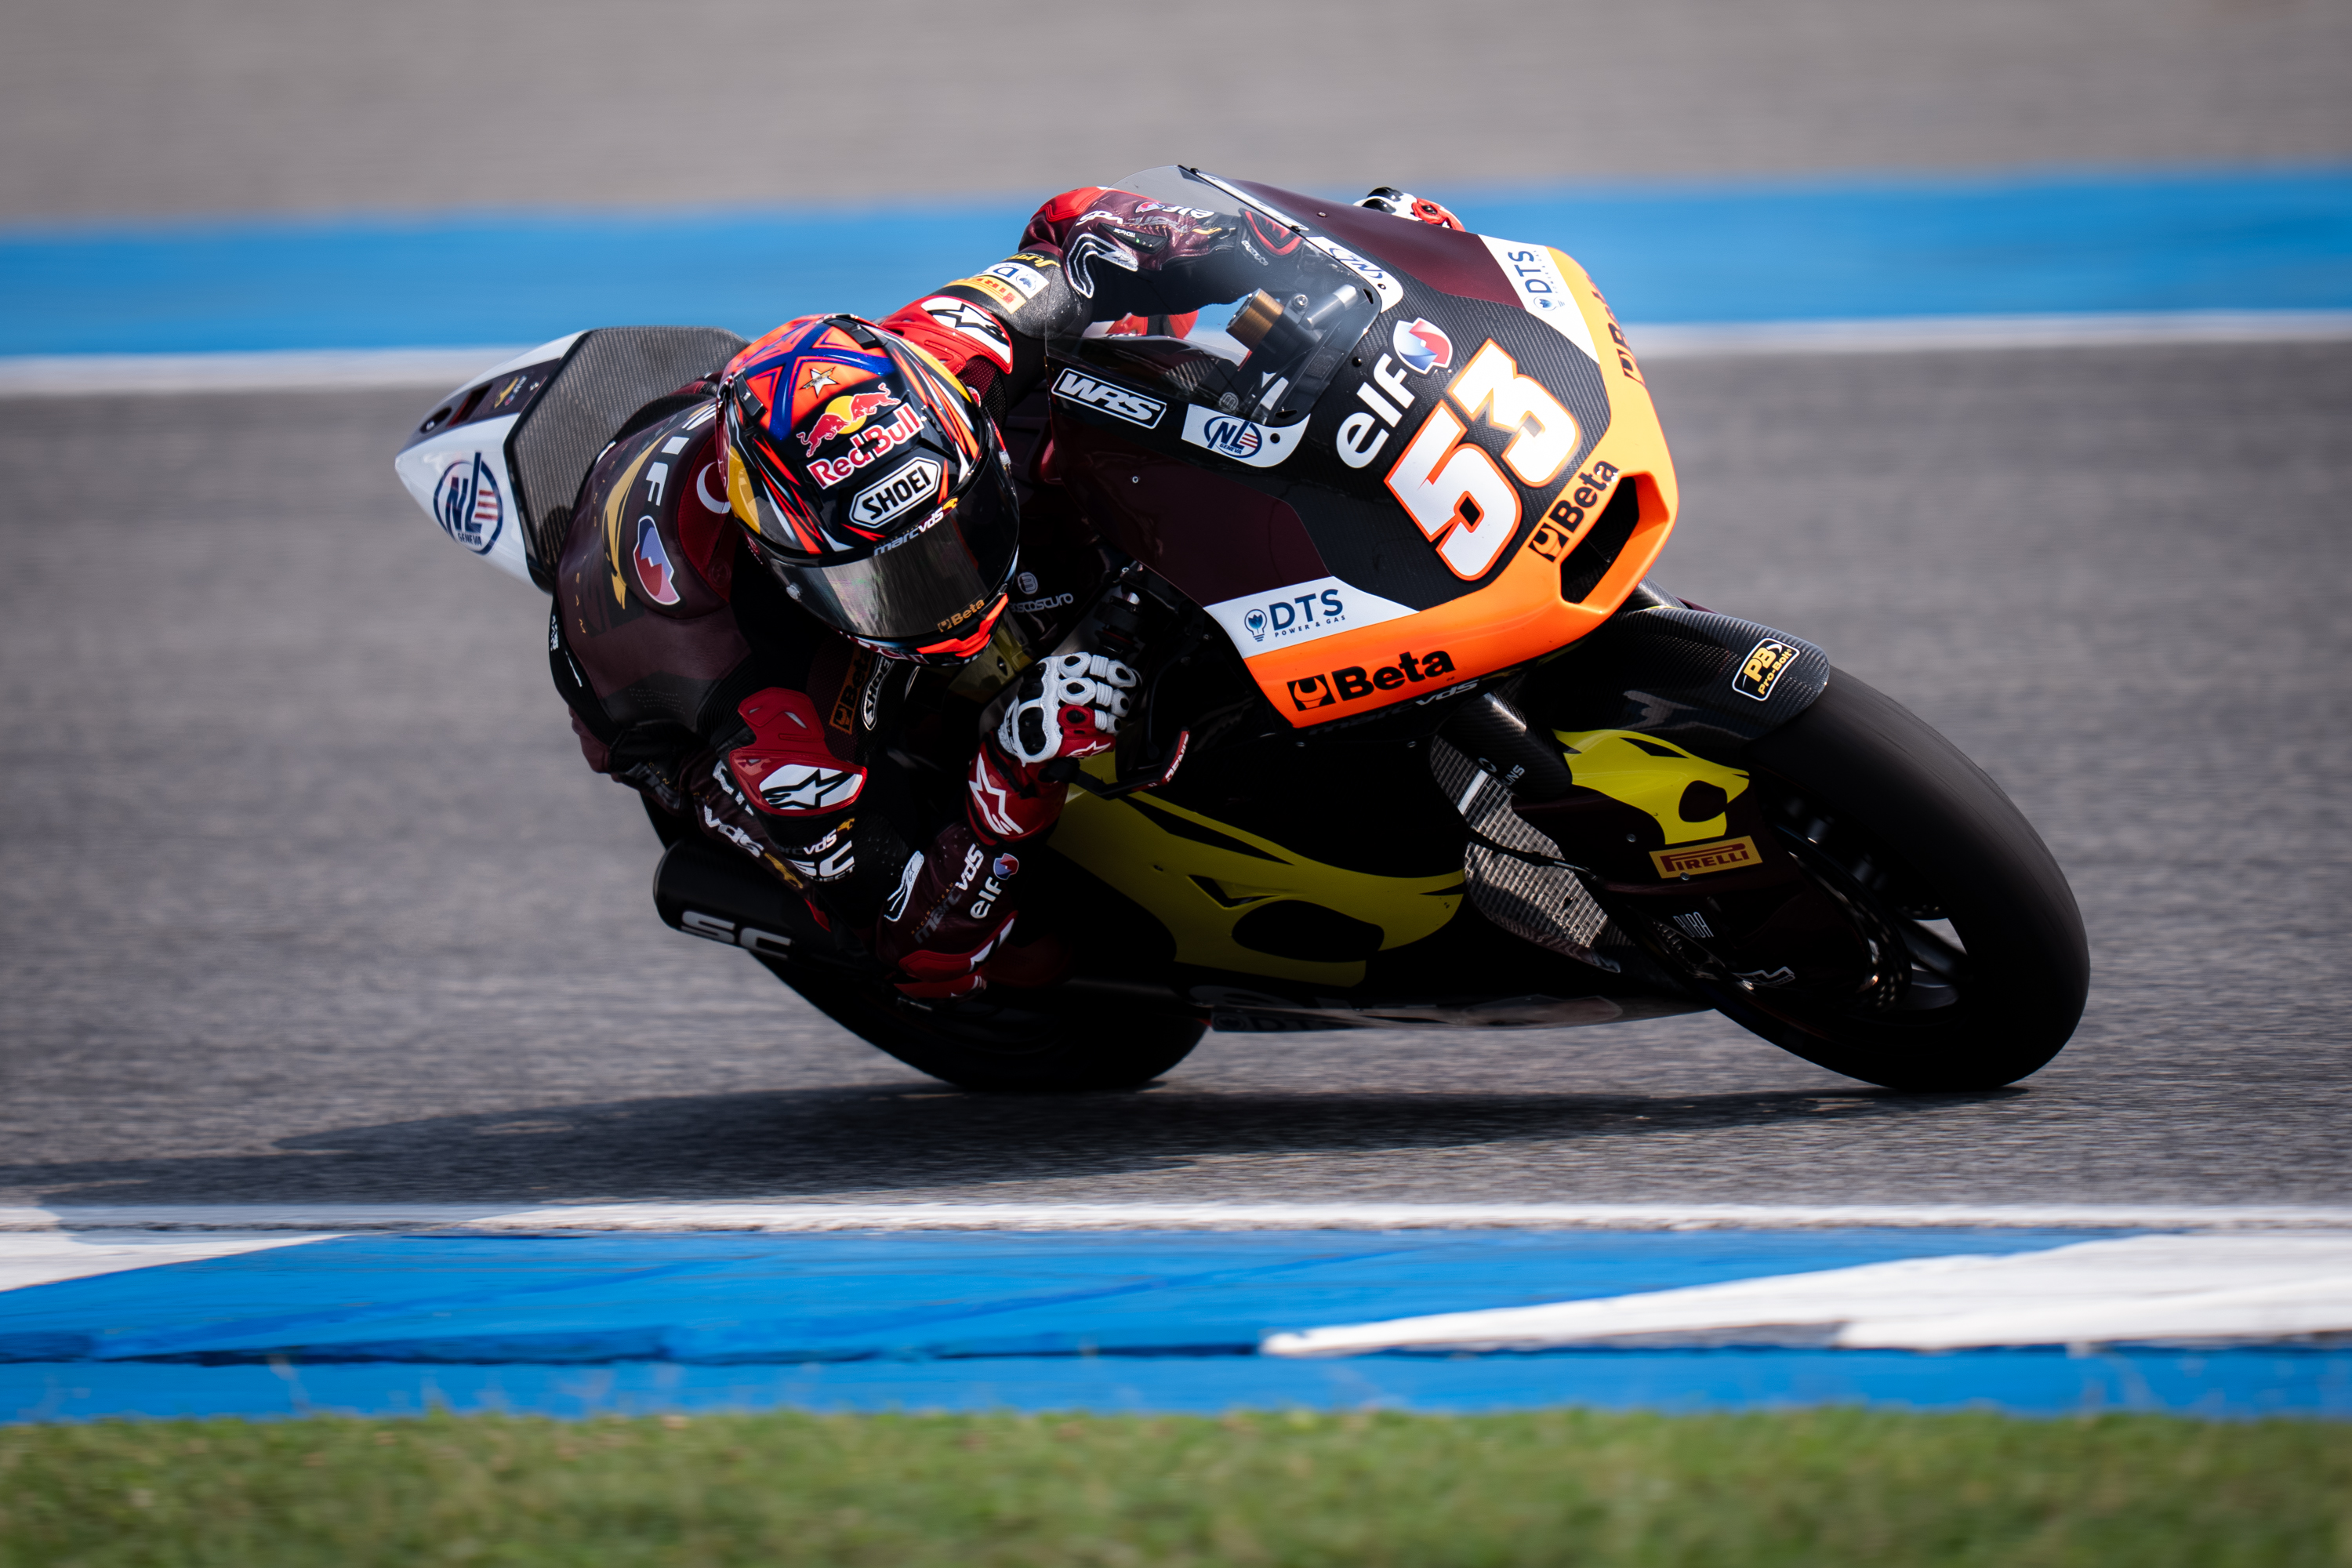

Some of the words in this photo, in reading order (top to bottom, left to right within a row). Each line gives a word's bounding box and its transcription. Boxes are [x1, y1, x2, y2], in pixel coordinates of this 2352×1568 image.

[1508, 250, 1553, 293] DTS
[1058, 372, 1161, 421] WRS
[1336, 353, 1416, 469] elf
[807, 433, 876, 489] Red
[862, 402, 925, 458] Bull
[1219, 443, 1243, 455] GENEVA
[1384, 337, 1581, 581] 53
[862, 465, 931, 521] SHOEI
[1548, 460, 1620, 534] Beta
[457, 532, 482, 546] GENEVA
[950, 599, 985, 626] Beta
[1269, 589, 1343, 631] DTS
[1275, 624, 1310, 638] POWER
[1326, 615, 1346, 624] GAS
[866, 656, 892, 718] SHOE
[1331, 650, 1457, 702] Beta
[1743, 647, 1777, 683] PB
[1500, 764, 1526, 787] LINS
[1660, 843, 1749, 872] PIRELLI
[970, 876, 1003, 920] elf
[681, 909, 793, 961] SC
